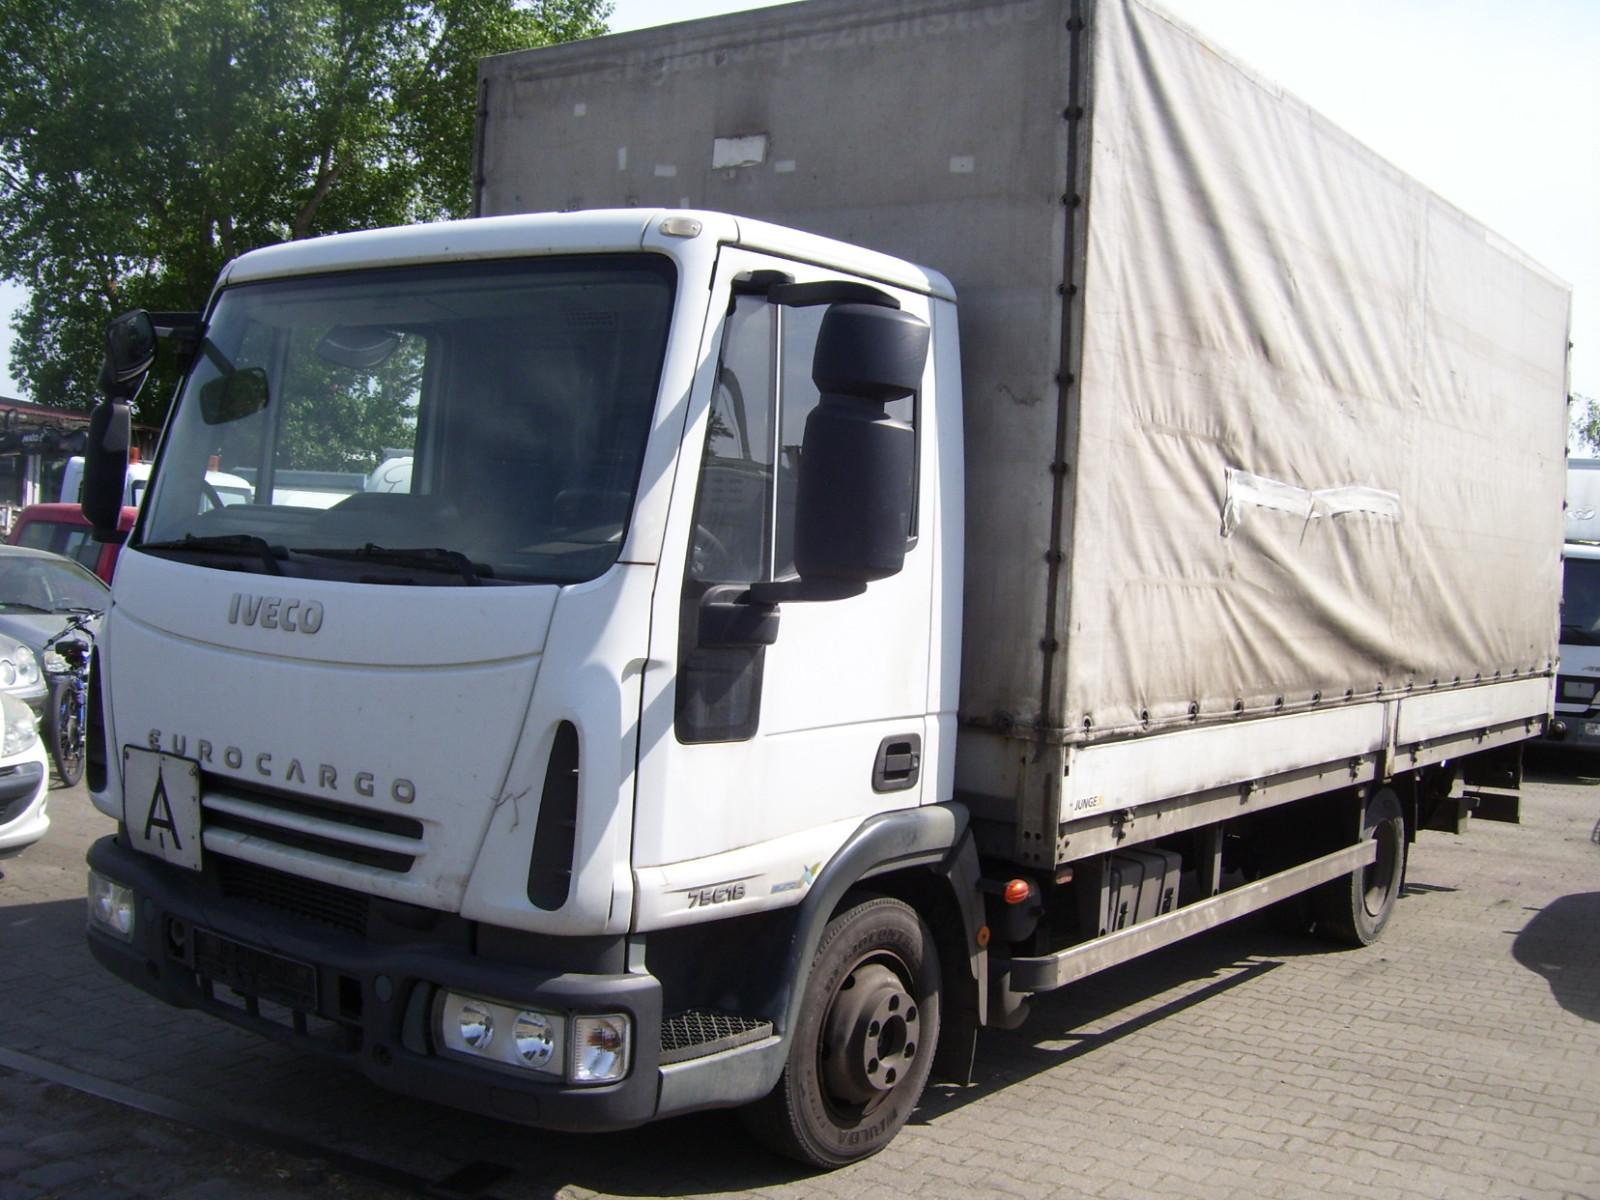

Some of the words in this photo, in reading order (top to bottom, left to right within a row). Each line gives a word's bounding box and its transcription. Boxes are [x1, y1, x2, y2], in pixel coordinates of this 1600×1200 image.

[228, 593, 324, 634] IVECO
[149, 729, 416, 804] EUROCARGO
[144, 767, 182, 850] A
